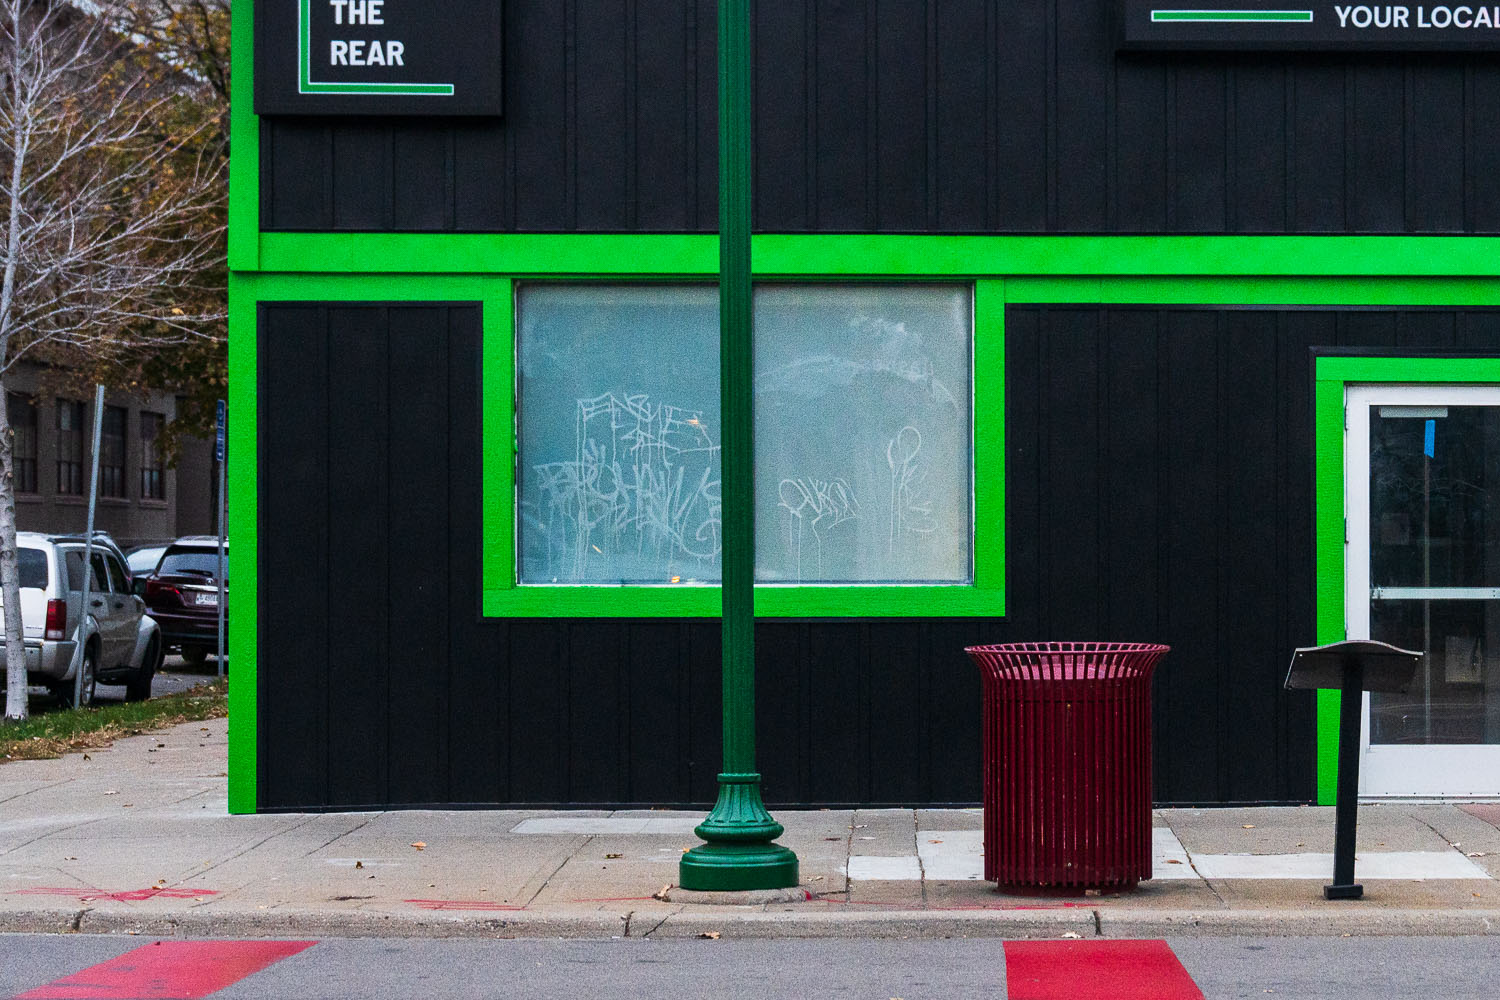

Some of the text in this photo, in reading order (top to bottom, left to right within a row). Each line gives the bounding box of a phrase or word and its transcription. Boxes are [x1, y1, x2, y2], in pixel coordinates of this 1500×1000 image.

[330, 0, 385, 25] THE
[1334, 5, 1409, 28] YOUR
[330, 40, 405, 66] REAR
